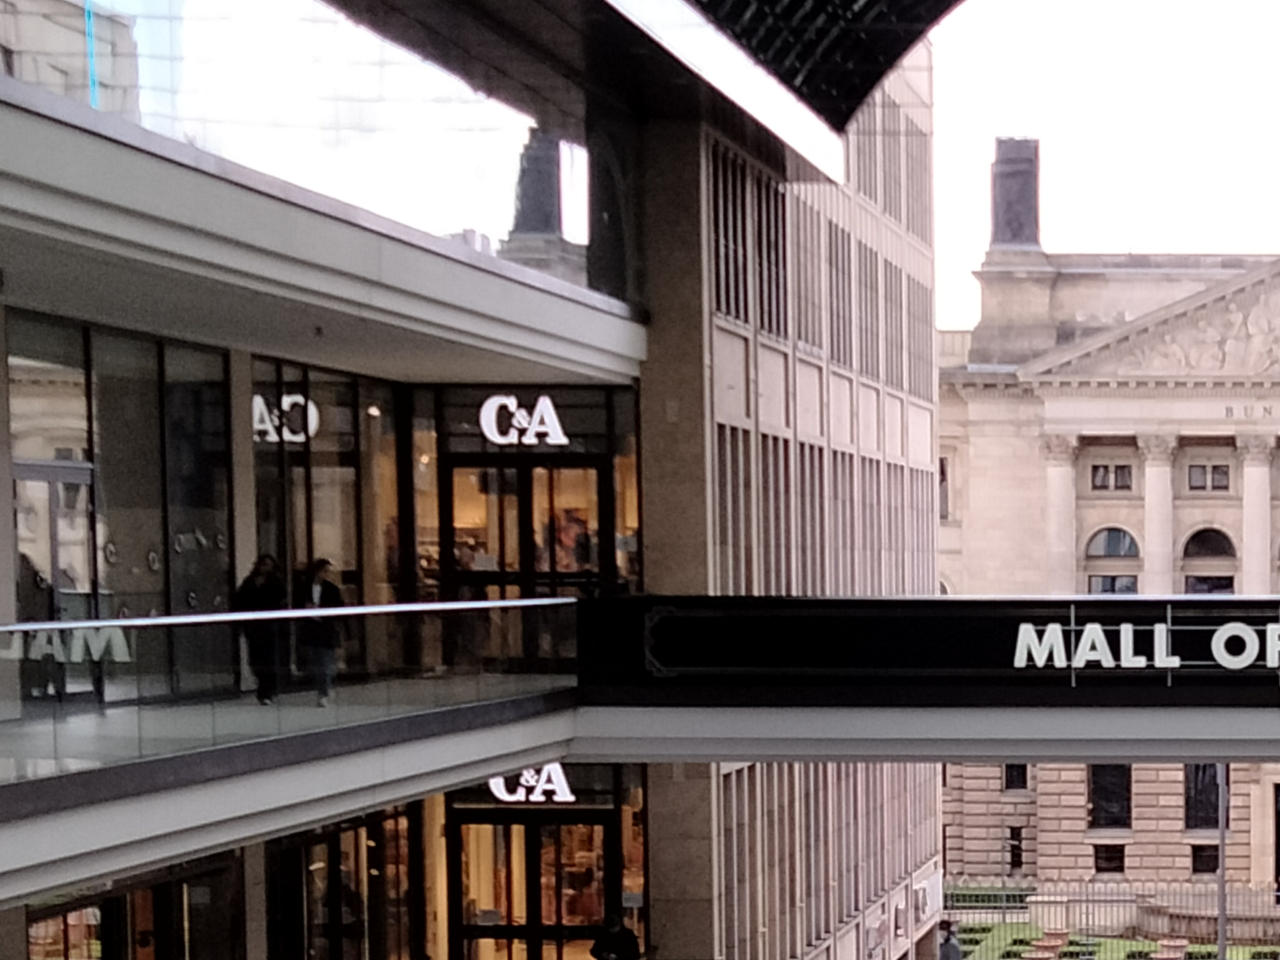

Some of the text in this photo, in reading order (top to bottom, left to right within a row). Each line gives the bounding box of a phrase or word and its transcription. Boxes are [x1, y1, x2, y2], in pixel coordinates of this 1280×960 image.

[480, 395, 569, 446] C&A
[1013, 622, 1181, 669] MALL
[488, 761, 577, 802] C&A
